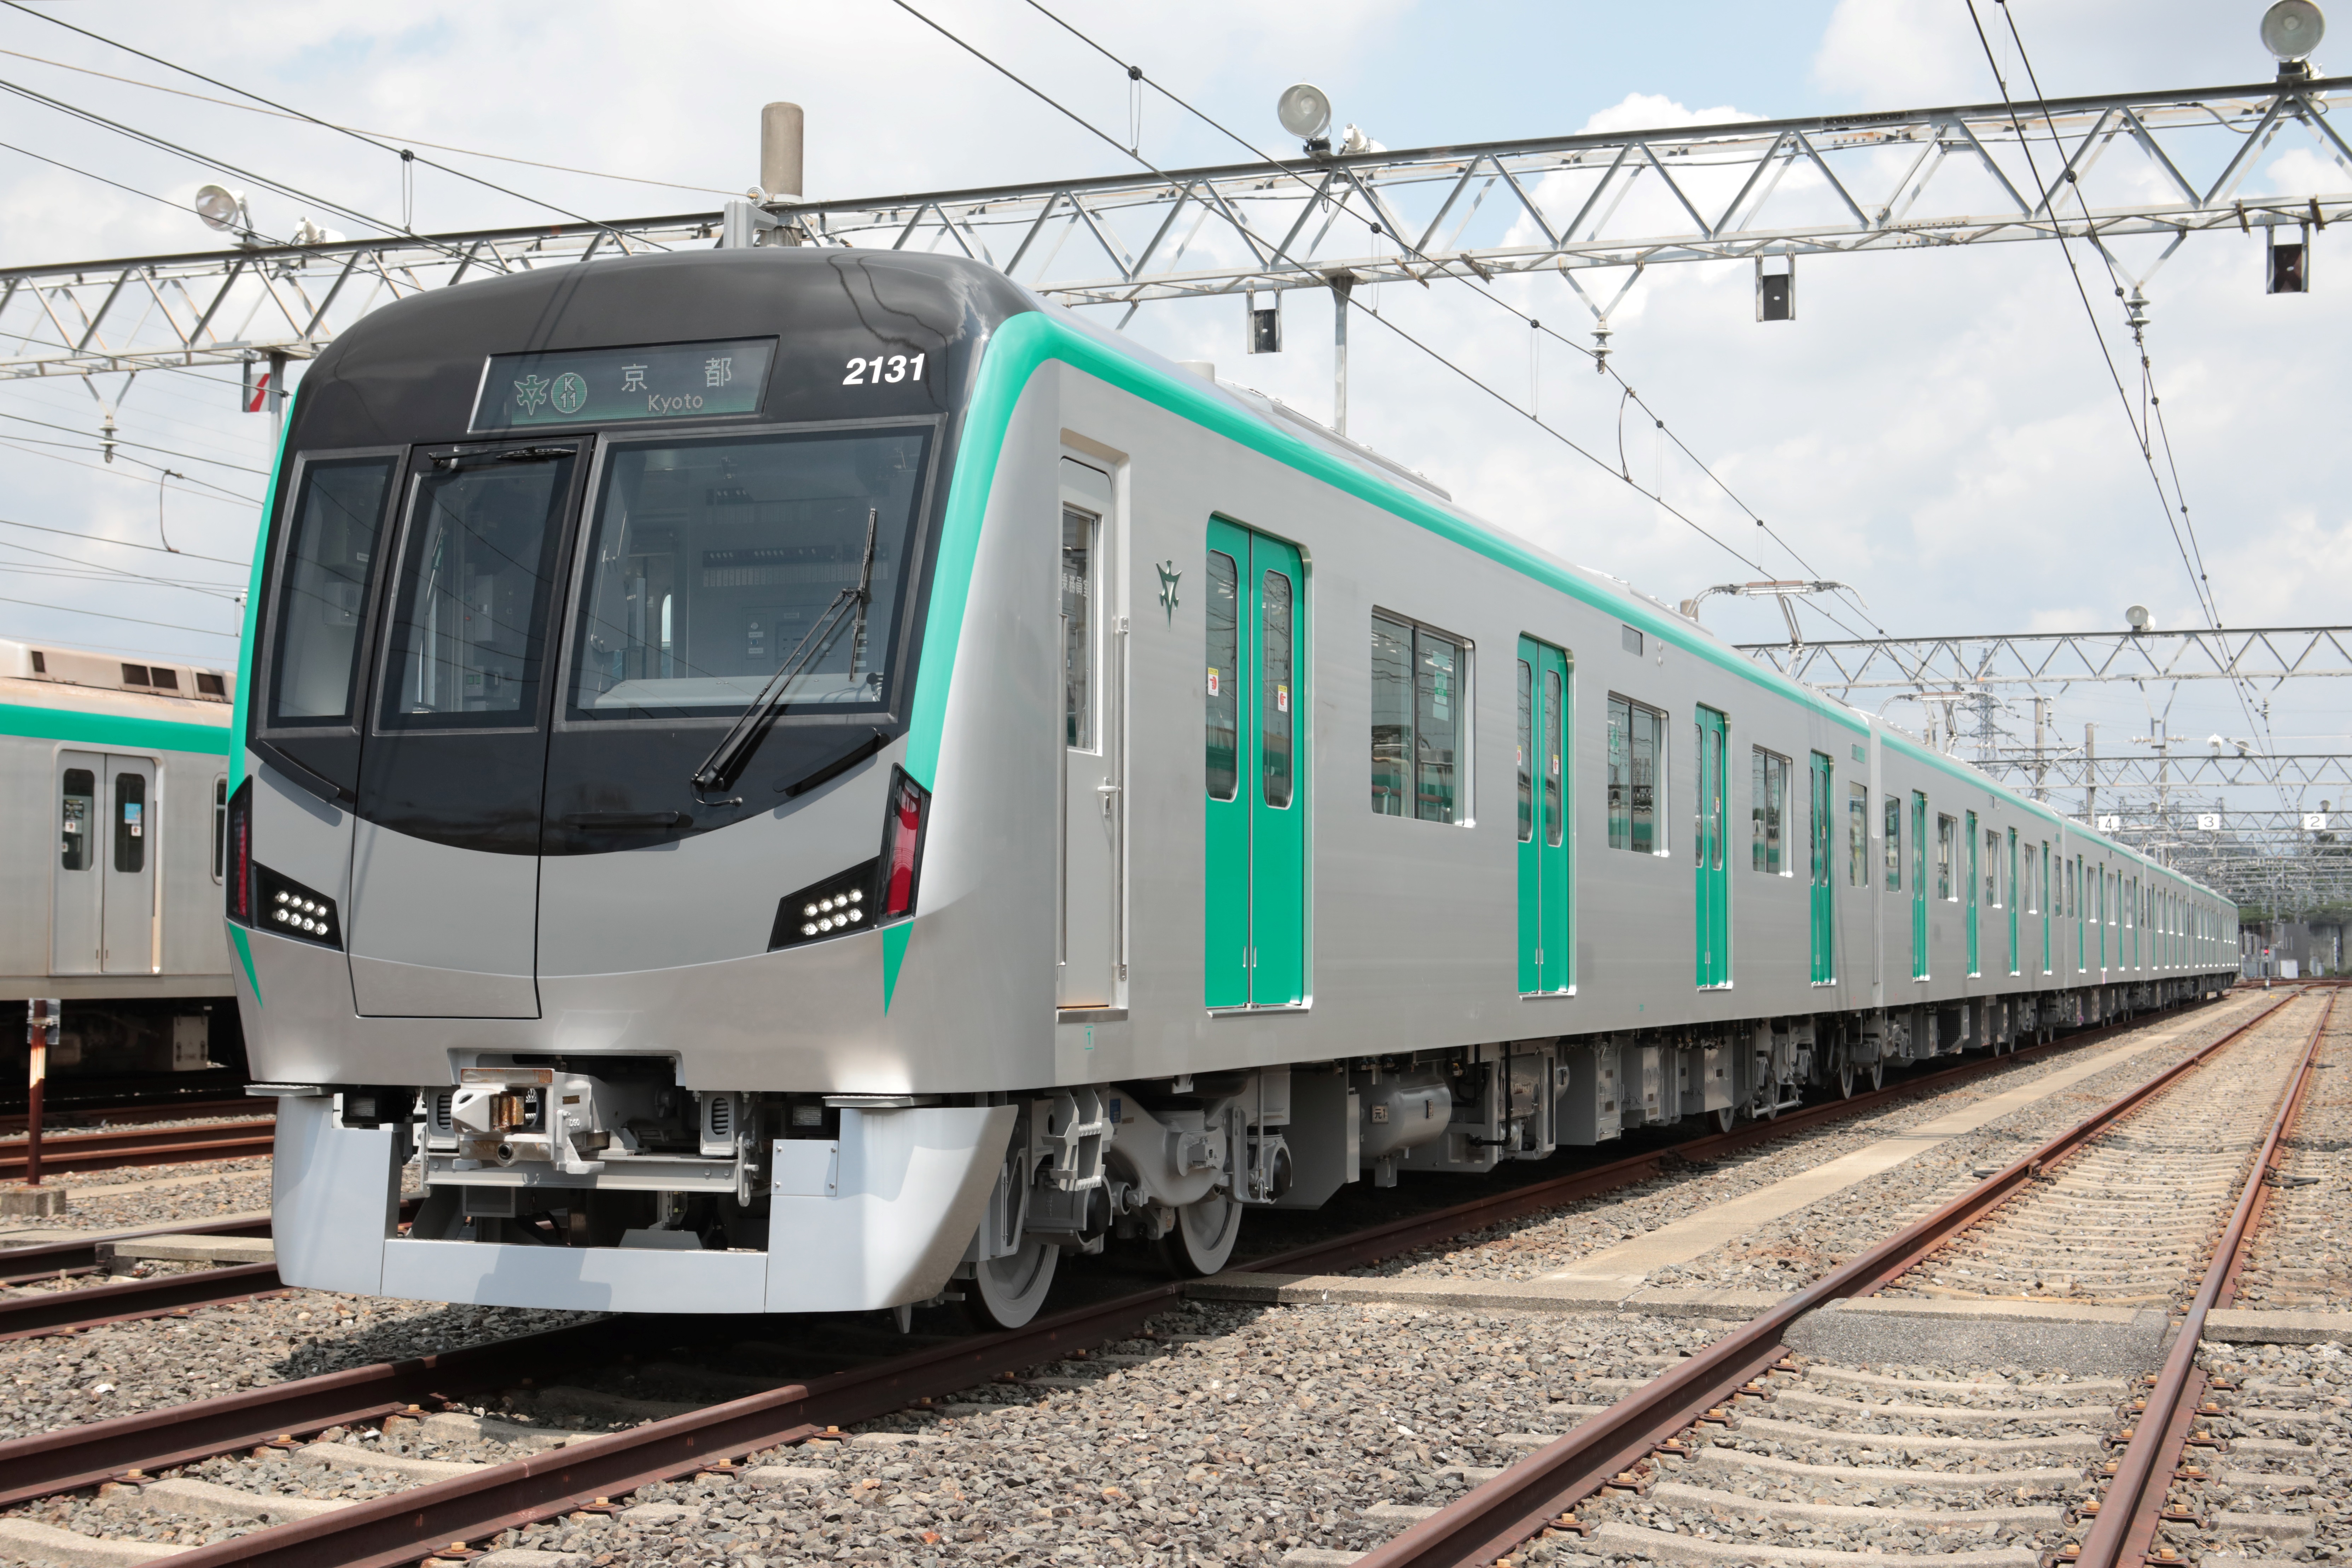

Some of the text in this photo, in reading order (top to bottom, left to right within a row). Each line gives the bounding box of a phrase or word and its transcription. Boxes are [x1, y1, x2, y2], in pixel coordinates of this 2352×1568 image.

[621, 357, 732, 392] 京都
[843, 353, 925, 385] 2131
[565, 377, 575, 391] K
[560, 392, 576, 408] 11
[648, 394, 703, 414] Kyoto
[1062, 573, 1089, 598] 乗務員室
[2105, 818, 2113, 830] 4
[2204, 816, 2214, 827] 3
[2310, 816, 2320, 827] 2
